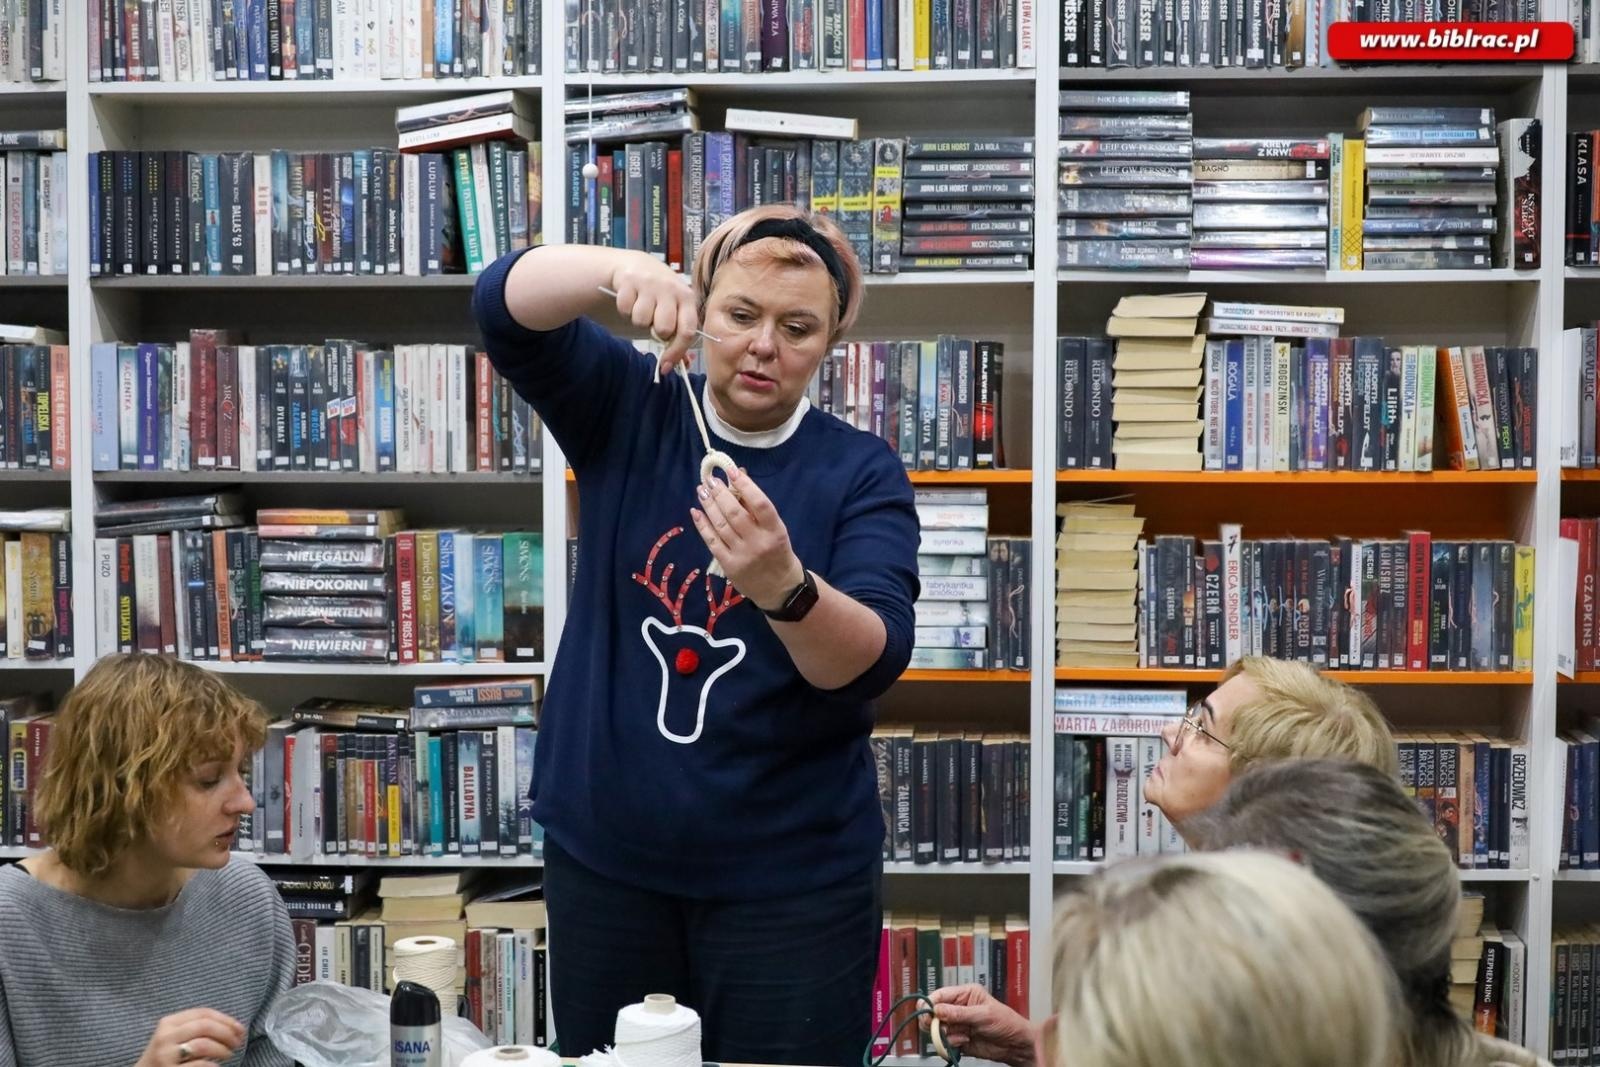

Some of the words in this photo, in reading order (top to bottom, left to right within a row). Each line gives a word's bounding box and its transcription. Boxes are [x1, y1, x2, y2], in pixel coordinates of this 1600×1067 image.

[833, 13, 841, 55] ZABÓJCZA
[1093, 20, 1102, 52] Nesser
[572, 152, 580, 169] LISA
[951, 143, 970, 151] HORST
[1262, 140, 1291, 148] KREW
[1577, 139, 1588, 185] KLASA
[950, 163, 968, 171] HORST
[191, 169, 204, 203] Kernick
[652, 185, 660, 216] POPIELATE
[950, 184, 968, 192] HORST
[12, 192, 20, 227] ESCAPE
[232, 205, 242, 233] DALLAS
[12, 229, 21, 259] ROOM
[652, 218, 660, 246] LALECZKI
[124, 360, 132, 411] PACJENTKA
[959, 350, 968, 404] BROADCHURCH
[1064, 359, 1073, 417] REDONDO
[1092, 359, 1101, 417] REDONDO
[1228, 362, 1237, 401] ROGALA
[1278, 364, 1290, 415] ROGOZIŃSKI
[1403, 364, 1415, 407] RUDNICKA
[1421, 366, 1432, 408] RUDNICKA
[1452, 364, 1468, 408] RUDNICKA
[1472, 362, 1489, 407] RUDNICKA
[1585, 360, 1594, 400] VUJICIC
[38, 392, 49, 431] TOPIELISKA
[923, 404, 931, 443] POKUTA
[1387, 388, 1398, 424] Lilith
[277, 406, 285, 444] DYLEMAT
[939, 409, 948, 447] EPIDEMIA
[1502, 426, 1510, 449] PECH
[102, 554, 111, 578] PUZO
[286, 551, 366, 562] NIELEGALNI
[423, 542, 434, 574] Daniel
[482, 545, 496, 593] SIMONS
[519, 541, 529, 581] SIMONS
[1228, 560, 1239, 590] ERICA
[1380, 546, 1391, 594] KOMISARZ
[285, 579, 368, 590] NIEPOKORNI
[423, 576, 434, 601] Silva
[926, 581, 974, 592] fabrykantka
[1206, 574, 1222, 614] CZERŃ
[1394, 545, 1405, 608] PROKURATOR
[402, 581, 412, 610] WOJNA
[441, 573, 454, 623] ZAKON
[1583, 574, 1594, 648] CZAPKINS
[401, 621, 413, 648] ROSJĄ
[1228, 593, 1239, 641] SPINDLER
[292, 640, 367, 651] NIEWIERNI
[1056, 717, 1097, 732] MARTA
[388, 742, 397, 784] AKUNIN
[1398, 749, 1407, 786] BRIGGS
[1406, 749, 1414, 786] PATRICIA
[1418, 749, 1427, 786] BRIGGS
[1439, 749, 1448, 786] BRIGGS
[463, 766, 475, 820] BALLADYNA
[1511, 754, 1526, 810] GRZĘDOWICZ
[1058, 803, 1068, 828] CISZY
[1116, 779, 1128, 823] DZIEDZICTWO
[1486, 948, 1495, 983] STEPHEN
[1484, 984, 1492, 1003] KING
[394, 1040, 431, 1054] ISANA
